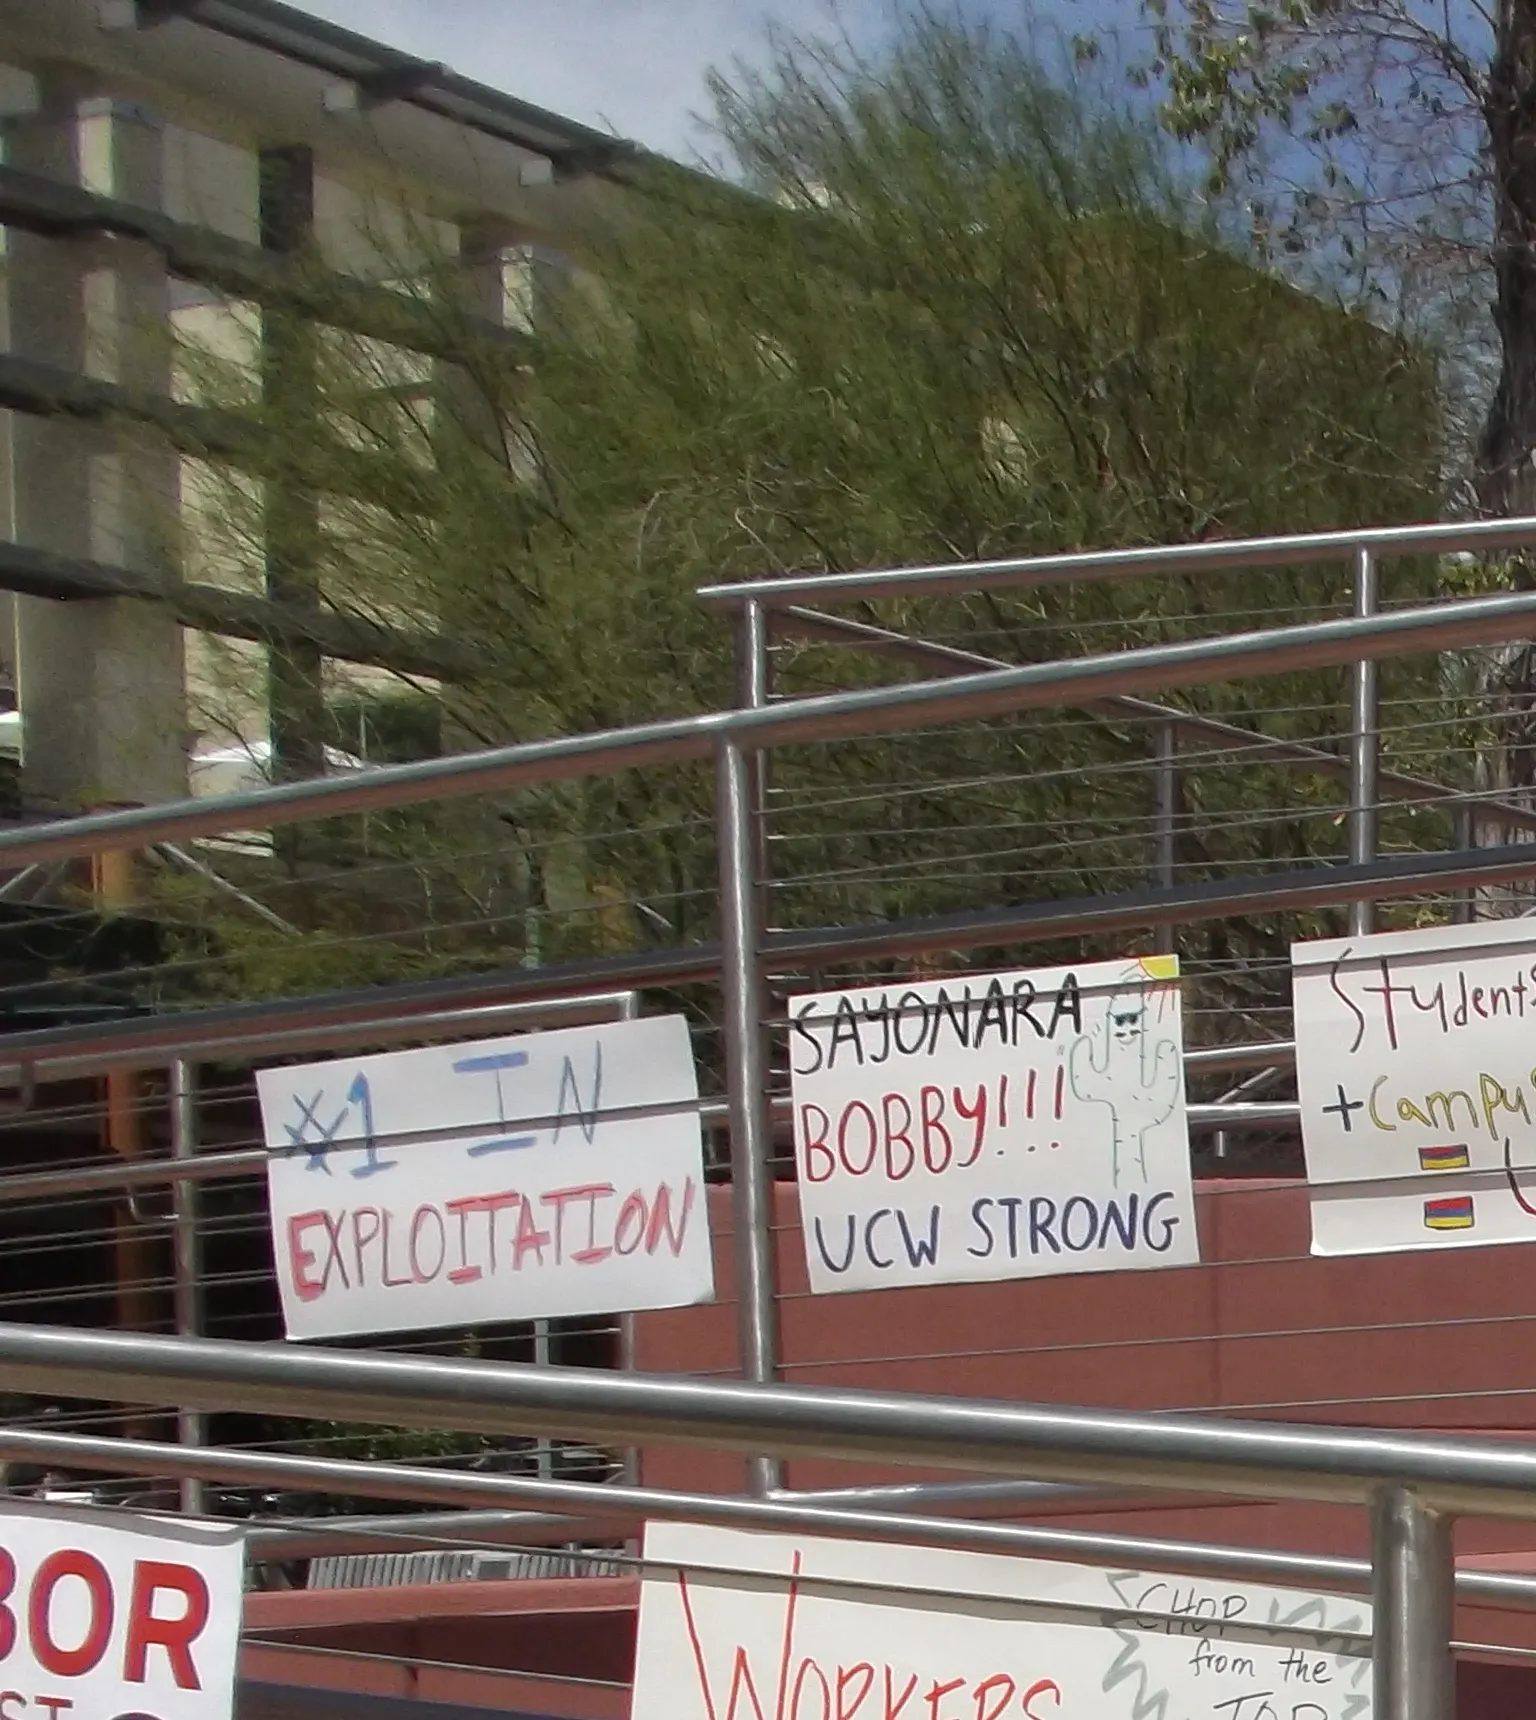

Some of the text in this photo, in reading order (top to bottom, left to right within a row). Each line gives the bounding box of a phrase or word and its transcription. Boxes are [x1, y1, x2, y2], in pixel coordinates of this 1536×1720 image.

[789, 972, 1084, 1075] SAYONARA
[451, 1039, 603, 1158] IN
[801, 1064, 1066, 1183] BOBBY!!!
[287, 1174, 696, 1302] EXPLOITATION
[815, 1190, 1181, 1273] UCW STRONG
[1188, 1636, 1333, 1685] from the
